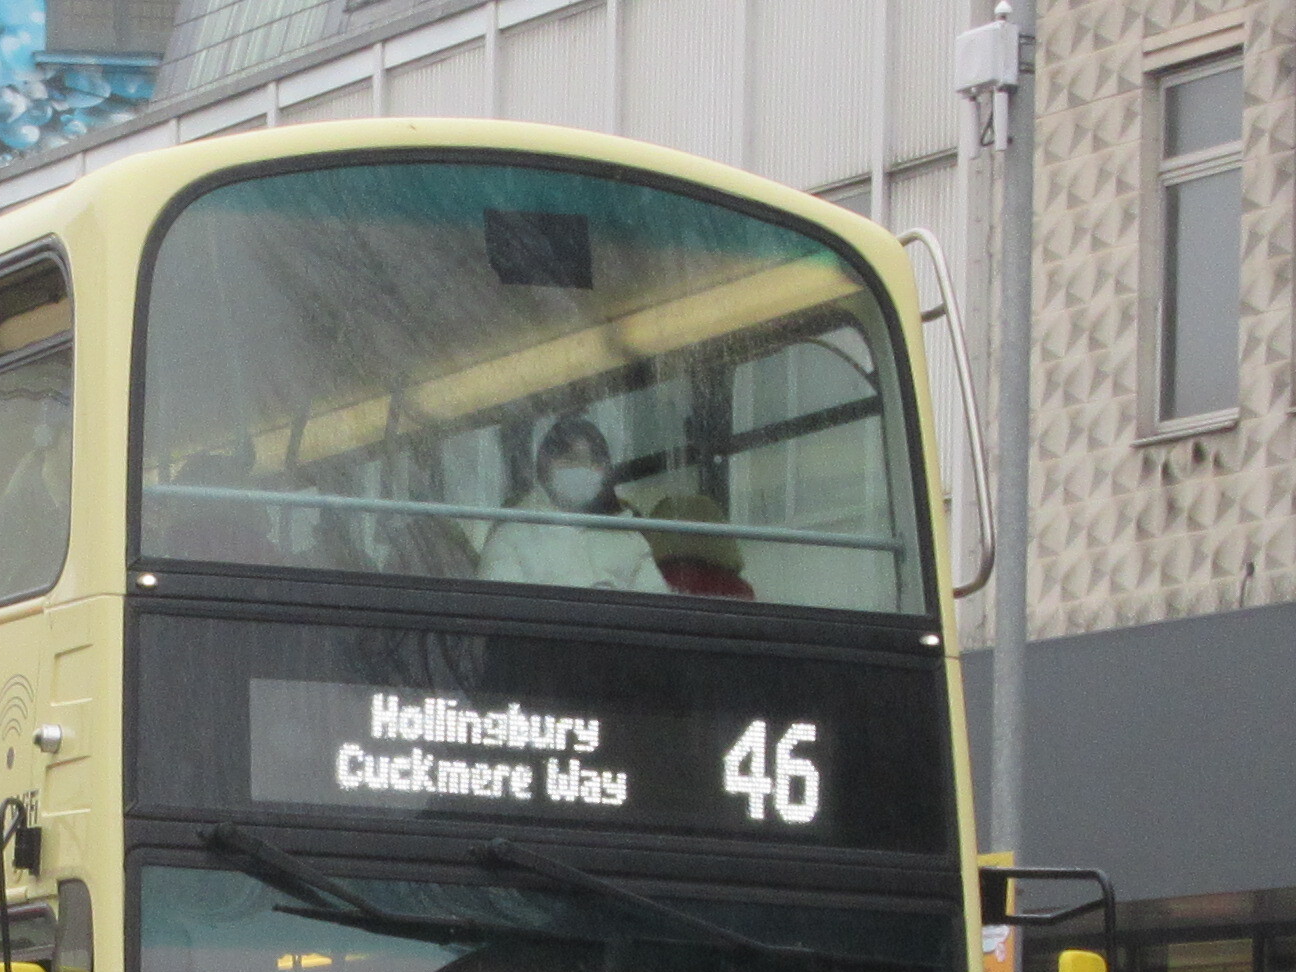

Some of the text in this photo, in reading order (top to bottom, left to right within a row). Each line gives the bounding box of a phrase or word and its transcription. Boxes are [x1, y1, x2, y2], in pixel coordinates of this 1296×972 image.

[370, 692, 599, 752] Hollingbury
[335, 742, 627, 805] Cuckmere Way
[723, 719, 820, 824] 46
